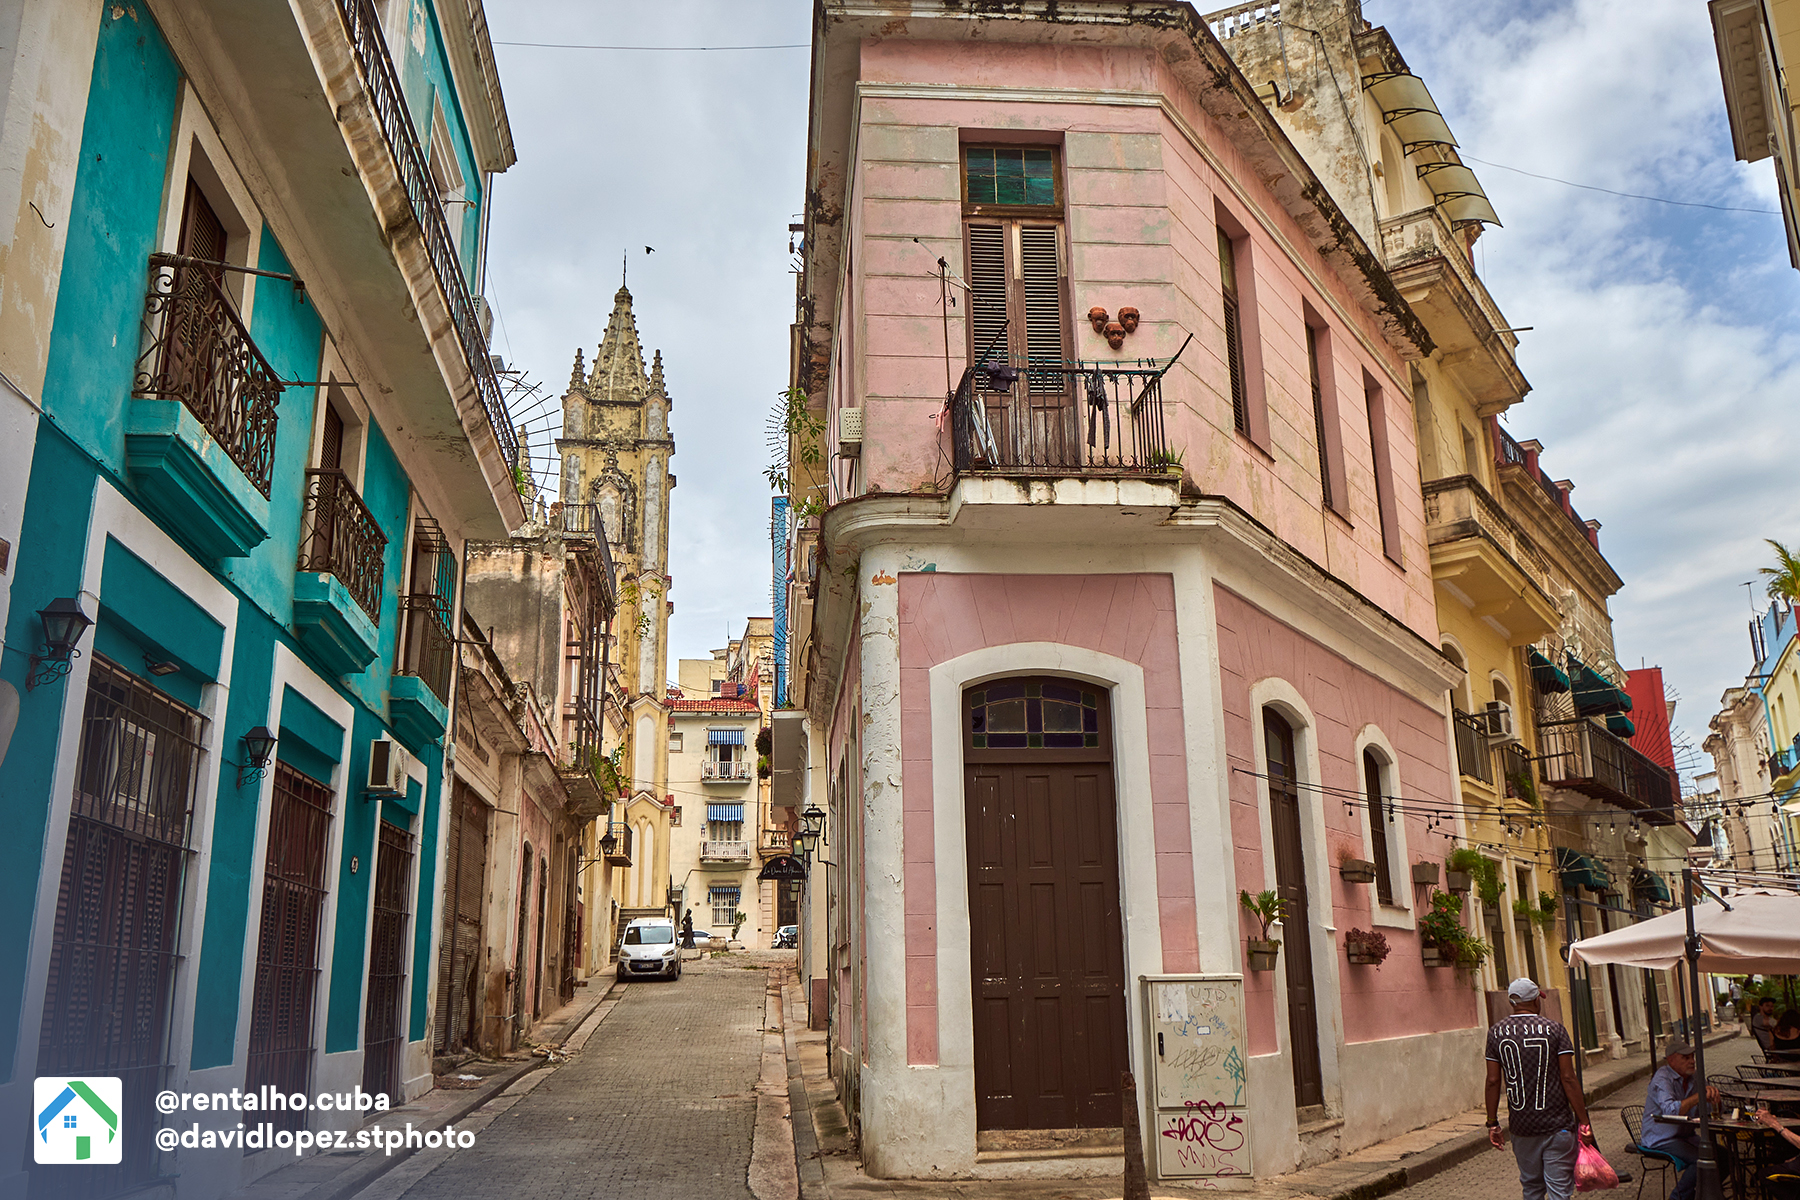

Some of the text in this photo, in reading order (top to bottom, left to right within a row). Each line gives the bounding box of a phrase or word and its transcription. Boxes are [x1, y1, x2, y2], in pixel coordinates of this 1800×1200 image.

[1494, 1024, 1551, 1038] EAST SIDE
[1499, 1037, 1549, 1110] 97
